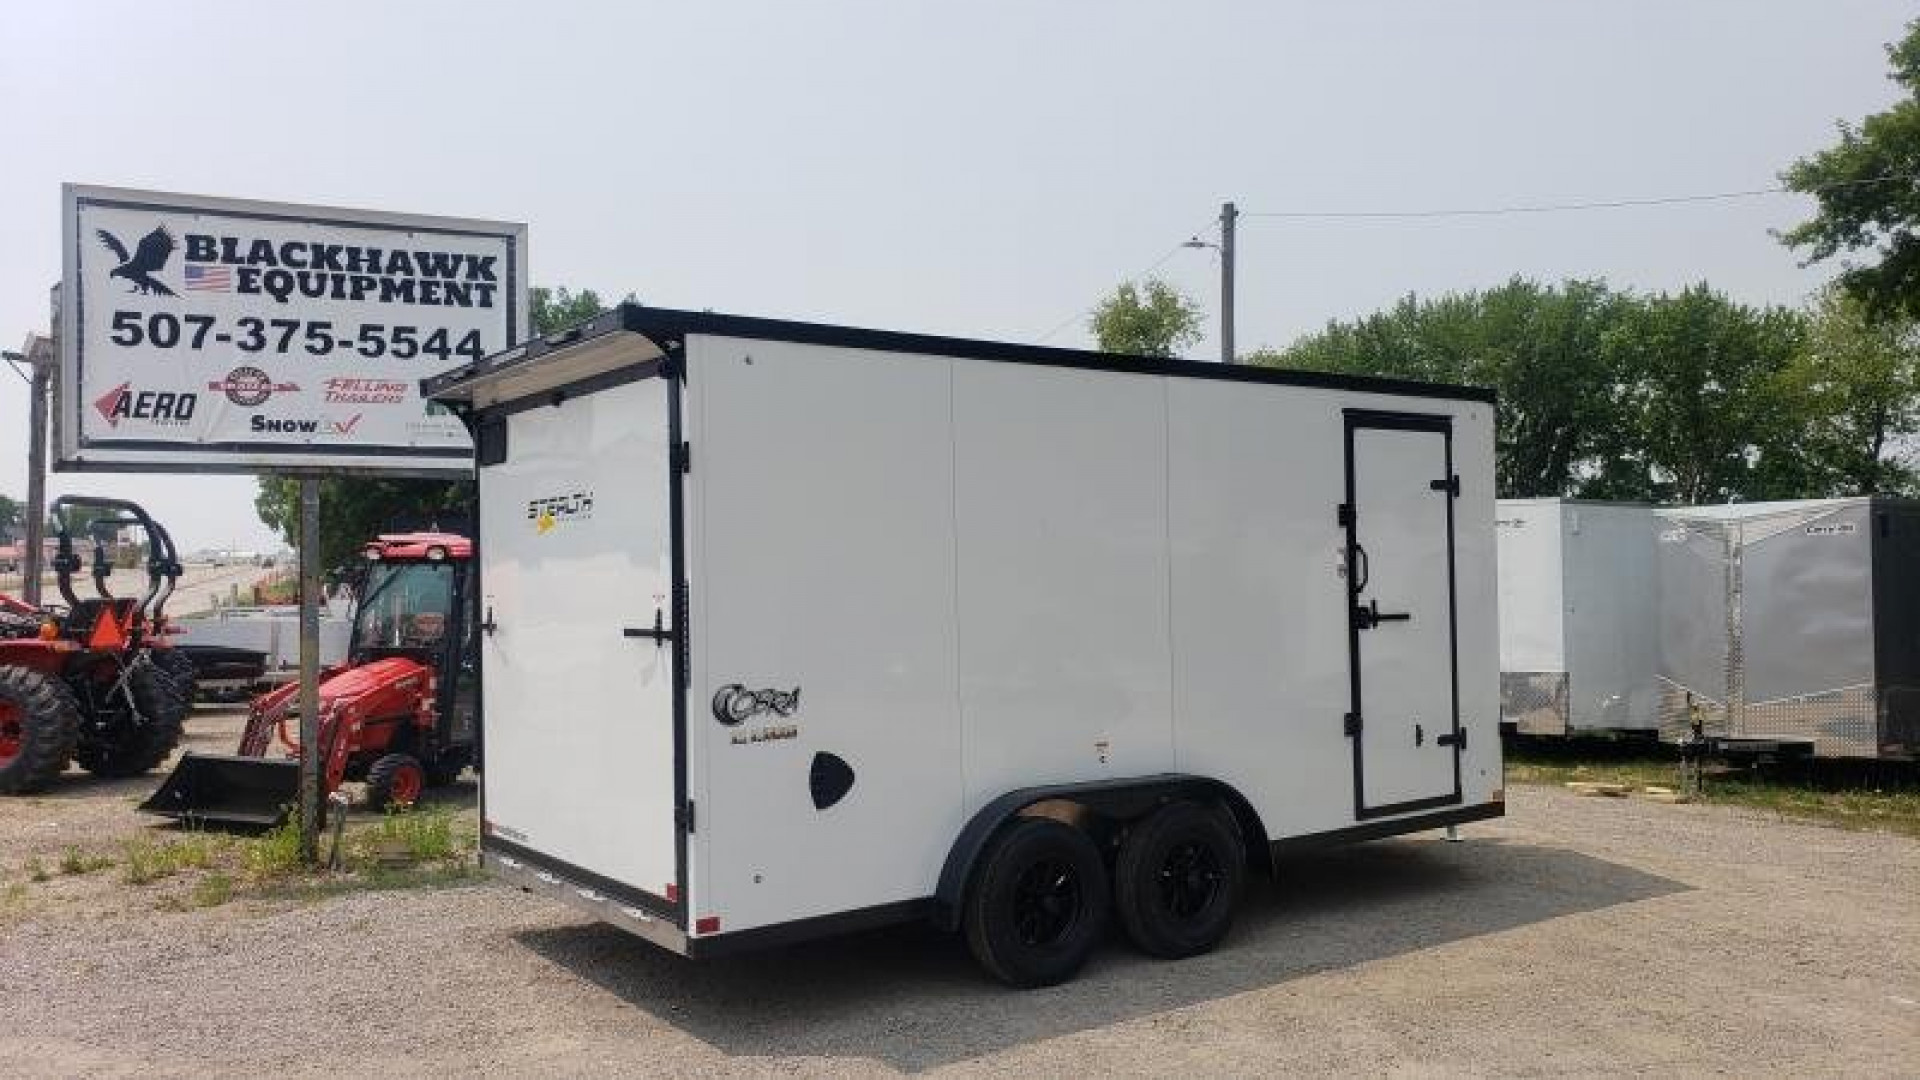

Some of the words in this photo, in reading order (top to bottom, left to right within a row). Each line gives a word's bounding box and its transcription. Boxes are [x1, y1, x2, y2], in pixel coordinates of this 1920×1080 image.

[184, 235, 497, 281] BLACKHAWK
[238, 268, 497, 307] EQUIPMENT
[110, 311, 486, 362] 507-375-5544
[111, 390, 198, 420] AERO
